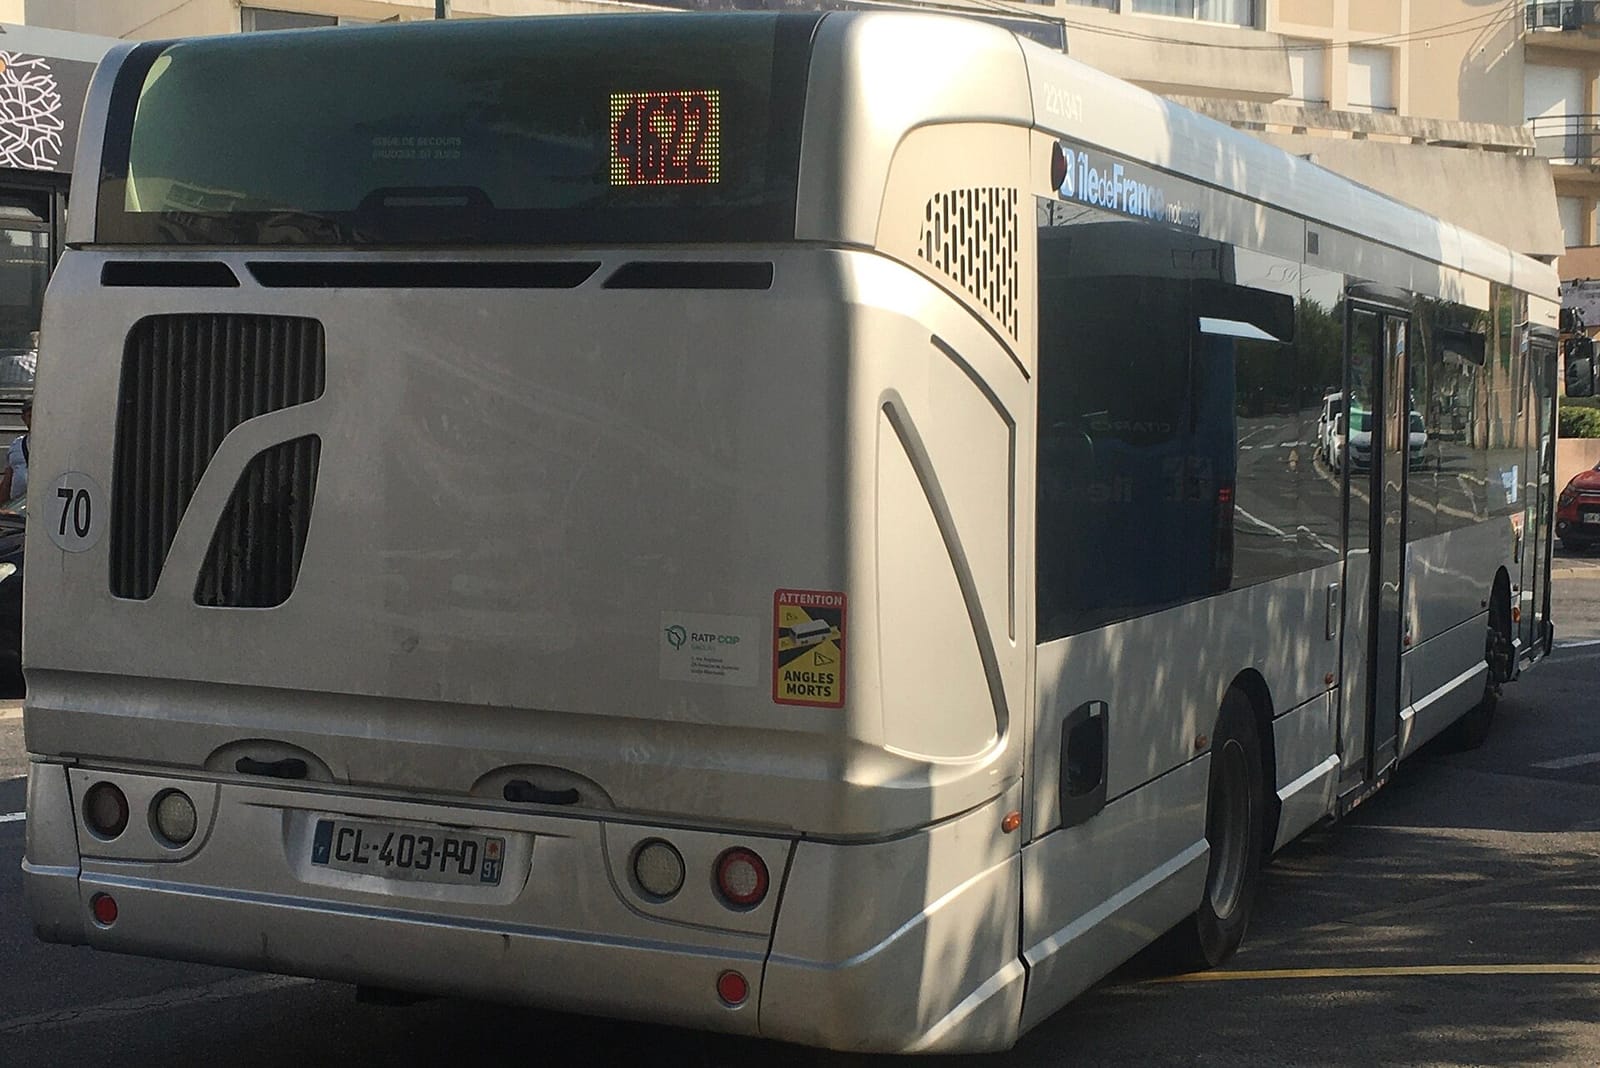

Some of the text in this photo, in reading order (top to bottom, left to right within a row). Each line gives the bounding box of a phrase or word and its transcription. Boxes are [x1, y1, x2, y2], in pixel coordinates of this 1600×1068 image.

[1043, 81, 1083, 123] 221347
[615, 95, 710, 182] 4622
[57, 487, 91, 538] 70
[779, 592, 842, 606] ATTENTION
[691, 633, 716, 643] RATP
[784, 670, 834, 684] ANGLES
[786, 683, 831, 697] MORTS
[335, 827, 499, 879] CL-403-PD 91
